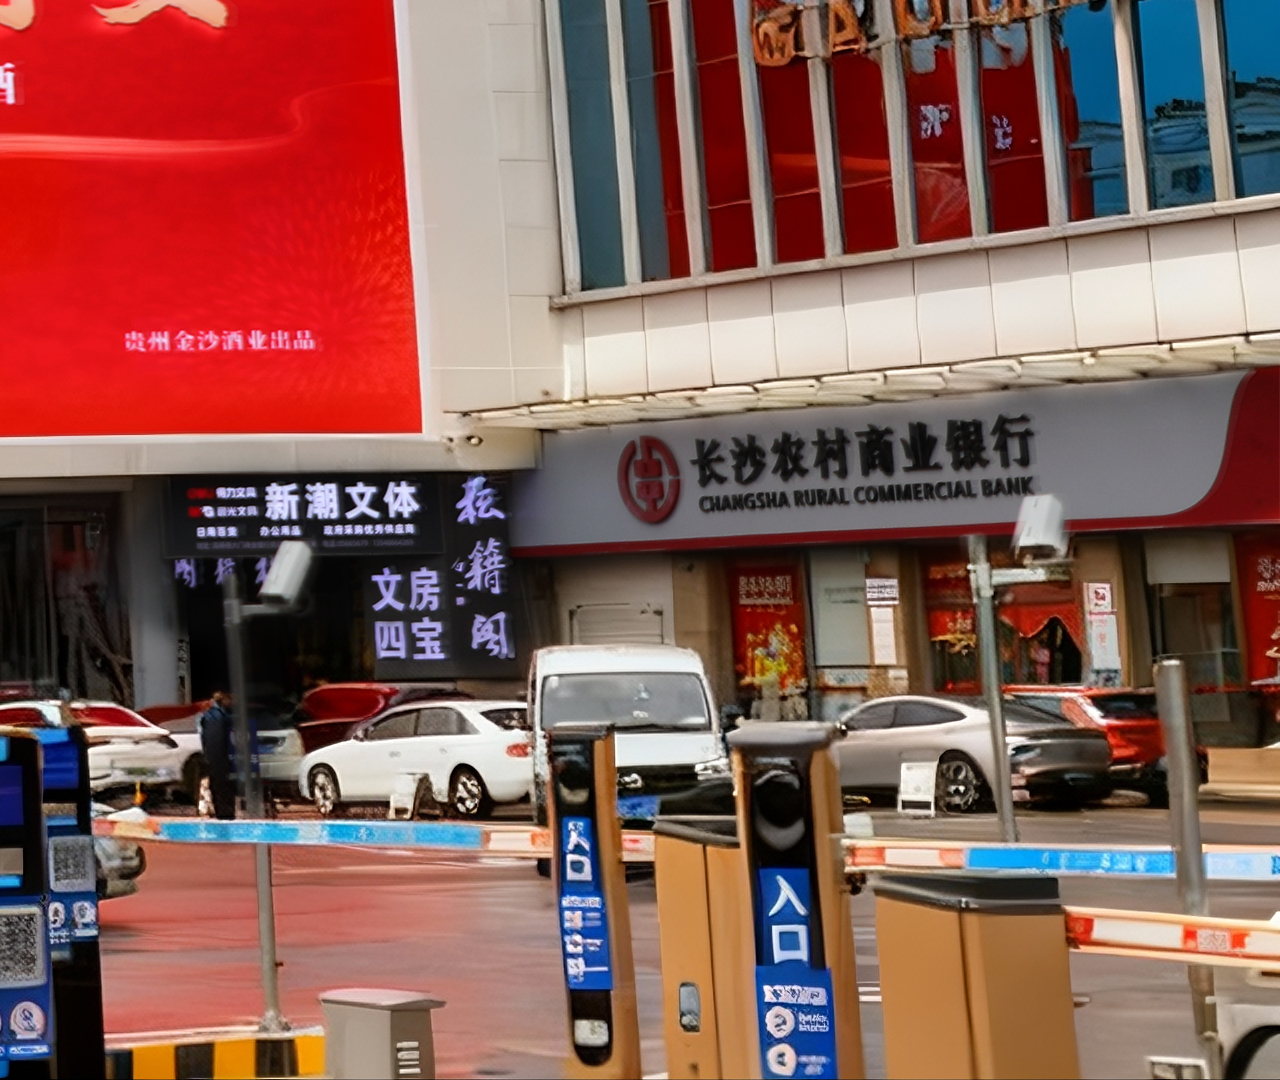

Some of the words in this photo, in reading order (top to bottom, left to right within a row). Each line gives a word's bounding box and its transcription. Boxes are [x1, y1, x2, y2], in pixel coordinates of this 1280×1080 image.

[124, 329, 317, 352] 贵州金沙酒业出品
[691, 414, 1036, 486] 长沙农村商业银行
[264, 481, 421, 521] 新潮文体
[698, 491, 791, 514] CHANGSHA
[793, 486, 849, 508] RURAL
[853, 479, 977, 505] COMMERCIAL
[981, 475, 1036, 497] BANK
[196, 525, 238, 538] 日用百货
[259, 523, 301, 536] 办公用品
[371, 566, 441, 612] 文房
[374, 619, 446, 660] 四宝
[767, 874, 809, 965] 入口
